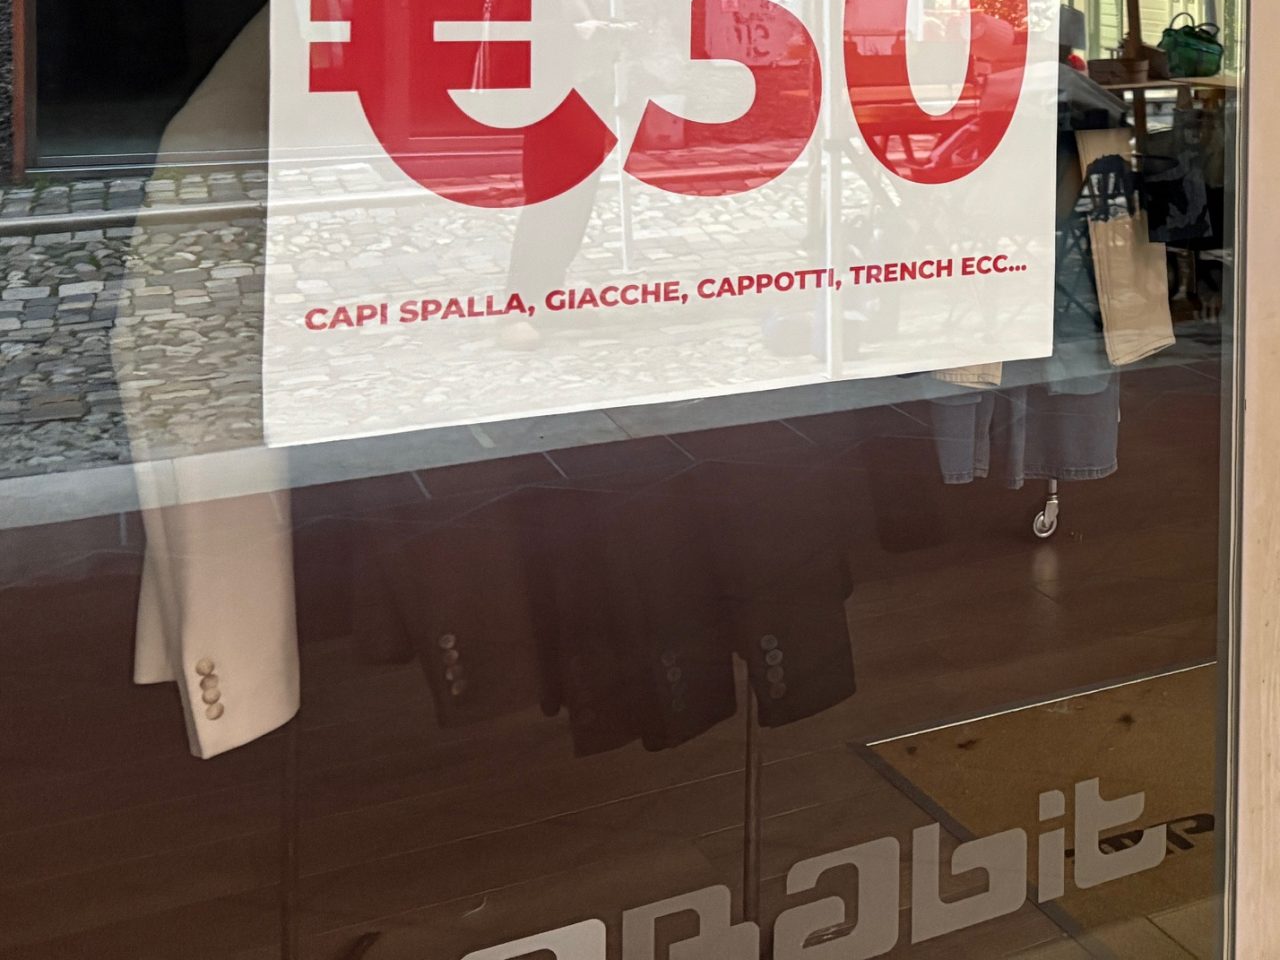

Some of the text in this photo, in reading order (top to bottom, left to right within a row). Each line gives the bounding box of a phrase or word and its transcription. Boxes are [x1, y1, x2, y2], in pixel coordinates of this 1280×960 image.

[304, 254, 1028, 332] CAPI SPALLA, GIACCHE, CAPPOTTI, TRENCH ECC...
